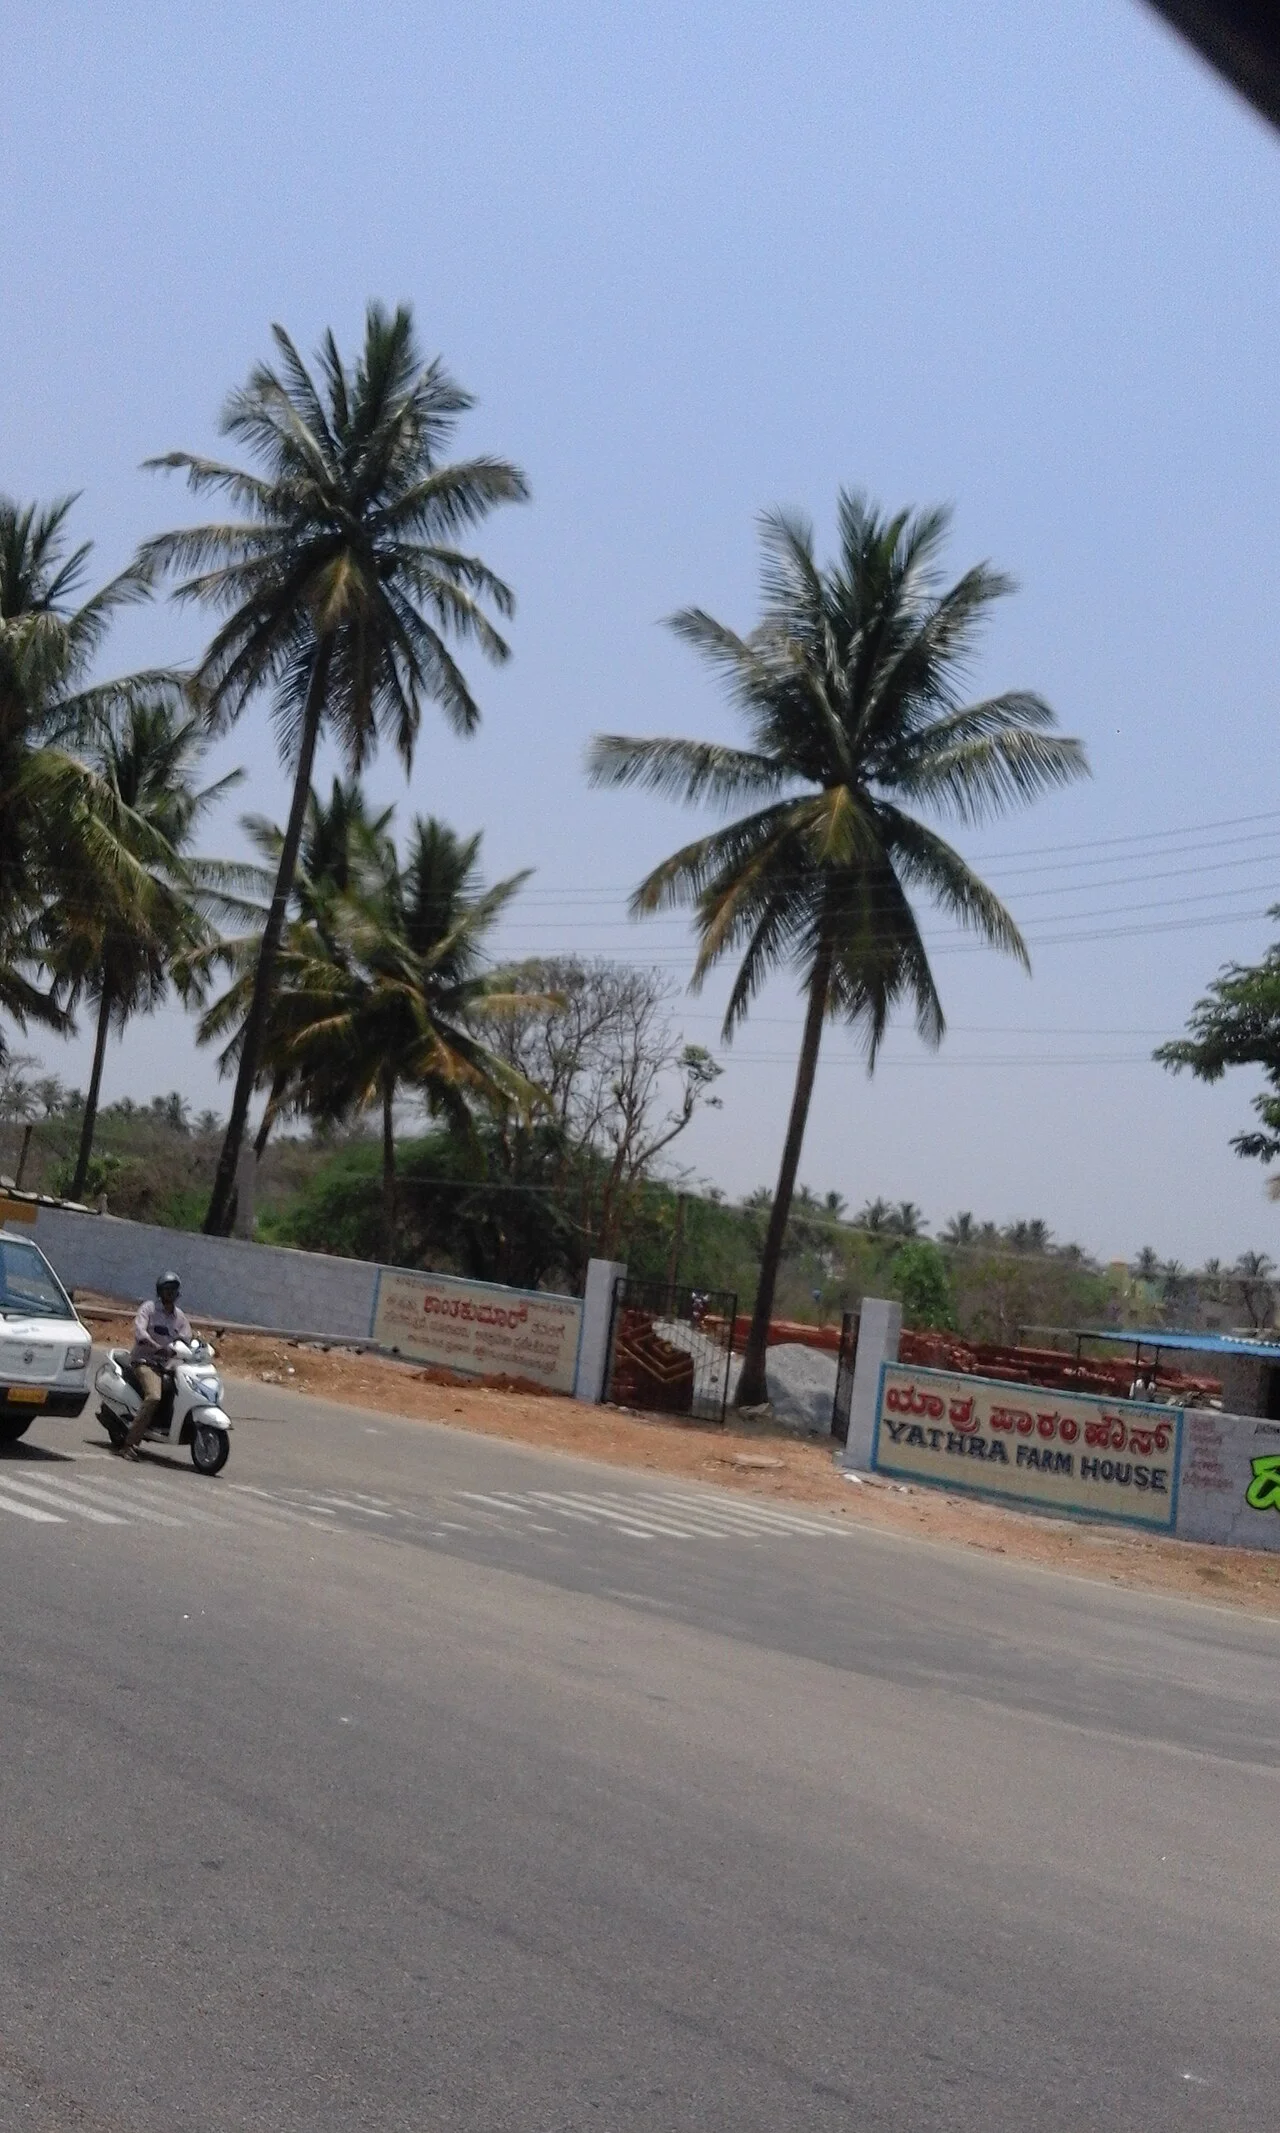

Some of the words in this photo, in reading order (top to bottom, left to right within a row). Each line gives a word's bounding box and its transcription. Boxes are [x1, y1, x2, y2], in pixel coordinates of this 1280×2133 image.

[883, 1418, 1009, 1465] YATHRA
[1016, 1443, 1074, 1477] FARM
[1080, 1455, 1169, 1494] HOUSE
